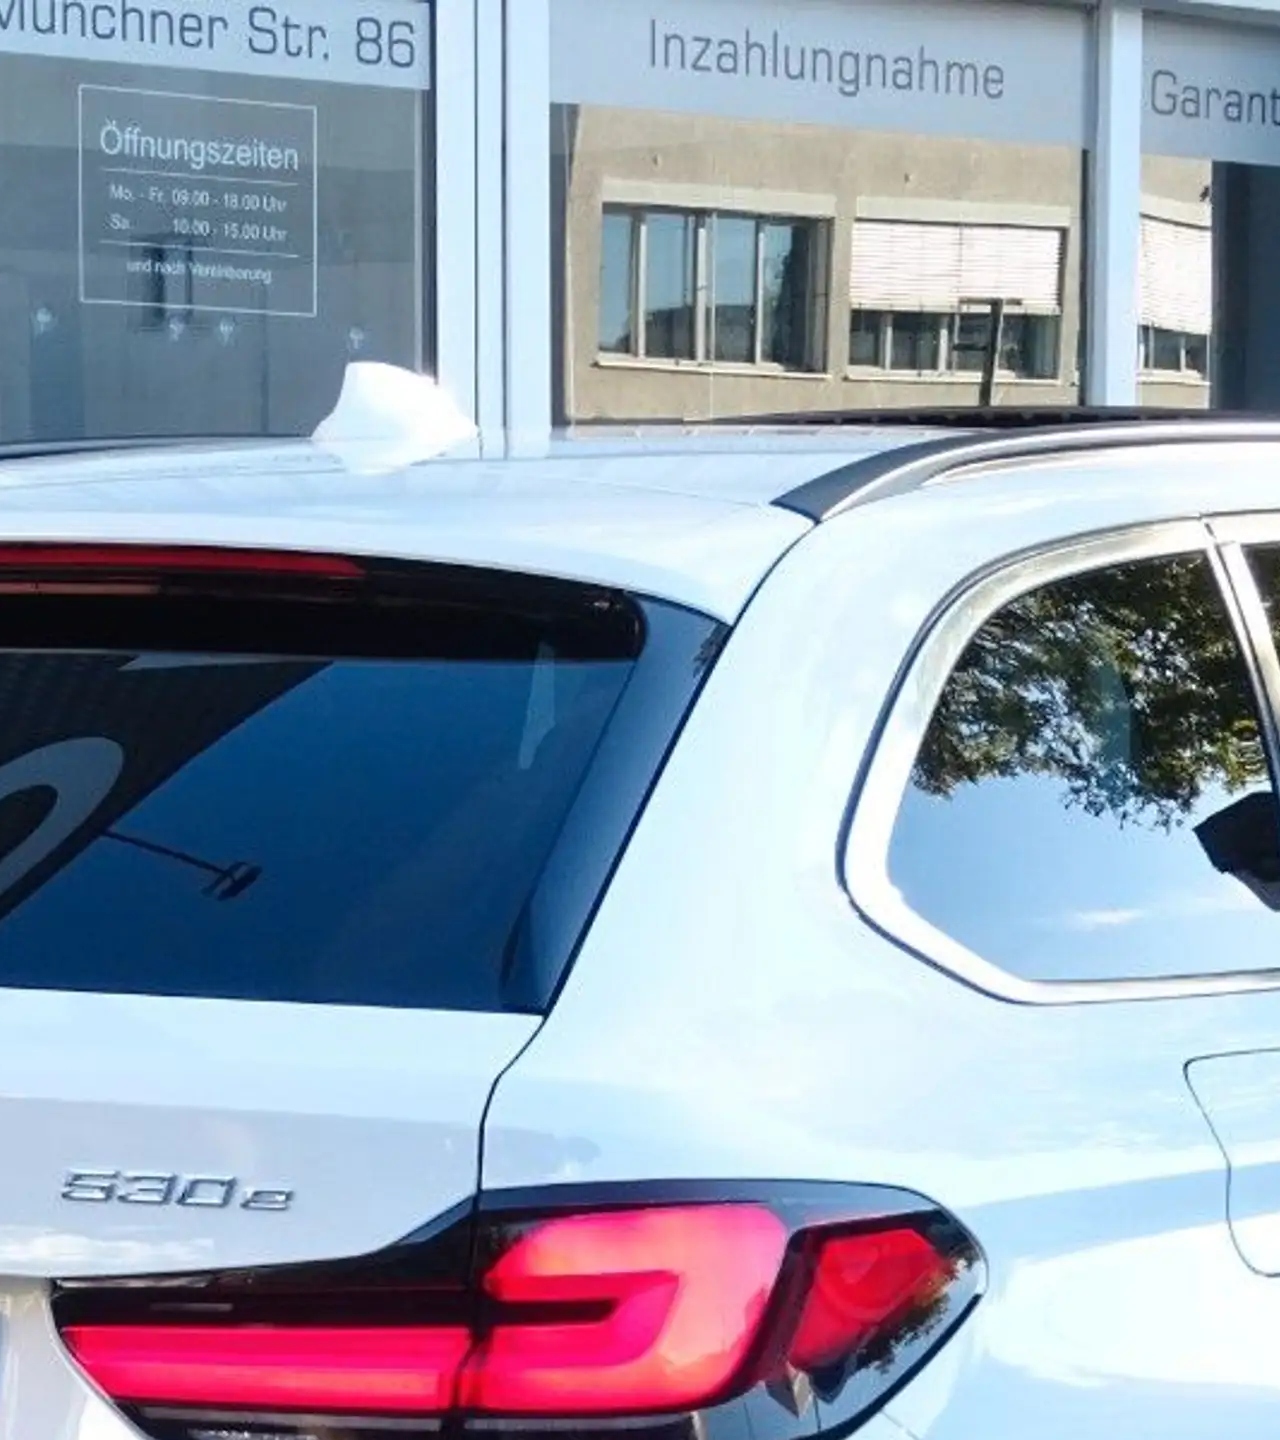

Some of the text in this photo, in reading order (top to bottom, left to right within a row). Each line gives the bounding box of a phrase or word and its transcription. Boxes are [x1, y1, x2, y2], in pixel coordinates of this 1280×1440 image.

[248, 6, 330, 60] Str.
[356, 16, 416, 69] 86
[649, 18, 1005, 99] Inzahlungnahme
[100, 117, 299, 170] Öffnungszeiten
